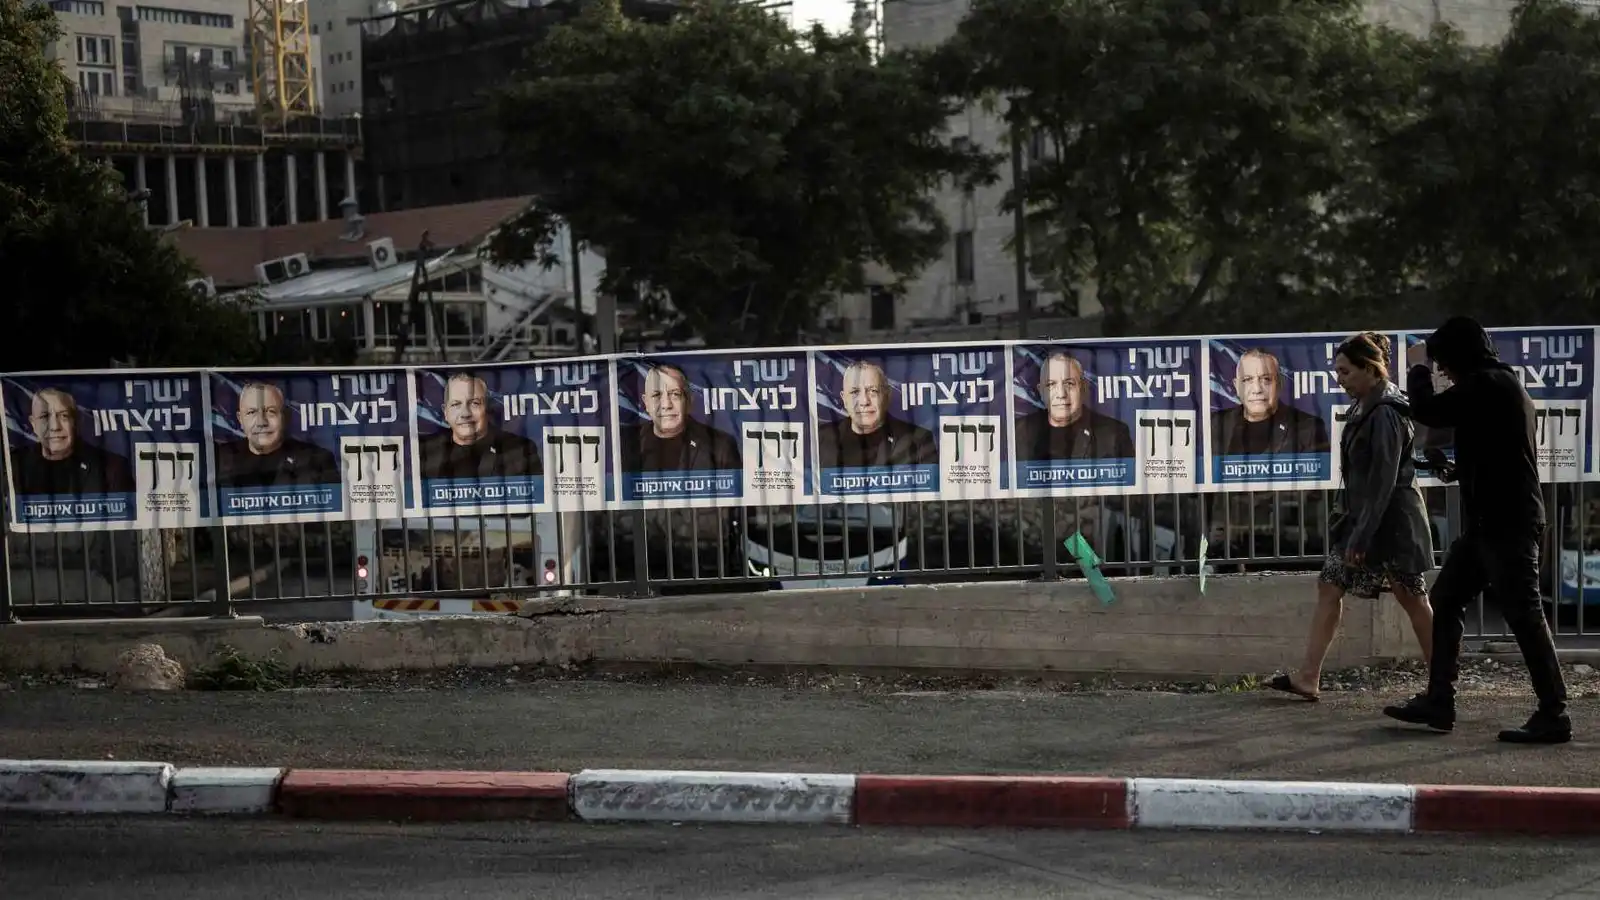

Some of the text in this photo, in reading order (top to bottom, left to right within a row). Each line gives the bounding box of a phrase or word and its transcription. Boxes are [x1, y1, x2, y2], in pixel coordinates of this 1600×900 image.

[1129, 346, 1189, 370] ישר!
[1522, 336, 1582, 359] ישר!
[535, 363, 597, 387] ישר!
[733, 359, 795, 382] ישר!
[932, 352, 993, 376] ישר!
[125, 378, 189, 403] ישר!
[331, 373, 395, 396] ישר!
[901, 377, 994, 410] לניצחון
[1098, 372, 1190, 403] לניצחון
[503, 388, 598, 420] לניצחון
[703, 384, 797, 414] לניצחון
[92, 405, 191, 436] לניצחון
[300, 398, 397, 431] לניצחון
[747, 429, 798, 468] דרך
[943, 424, 995, 462] דרך
[1140, 418, 1191, 456] דרך
[344, 444, 398, 481] דרך
[547, 434, 600, 473] דרך
[139, 451, 194, 489] דרך
[882, 474, 900, 485] עם
[1078, 468, 1097, 479] עם
[1273, 464, 1292, 474] עם
[485, 486, 504, 498] עם
[685, 479, 703, 491] עם
[75, 502, 96, 515] עם
[282, 495, 301, 506] עם
